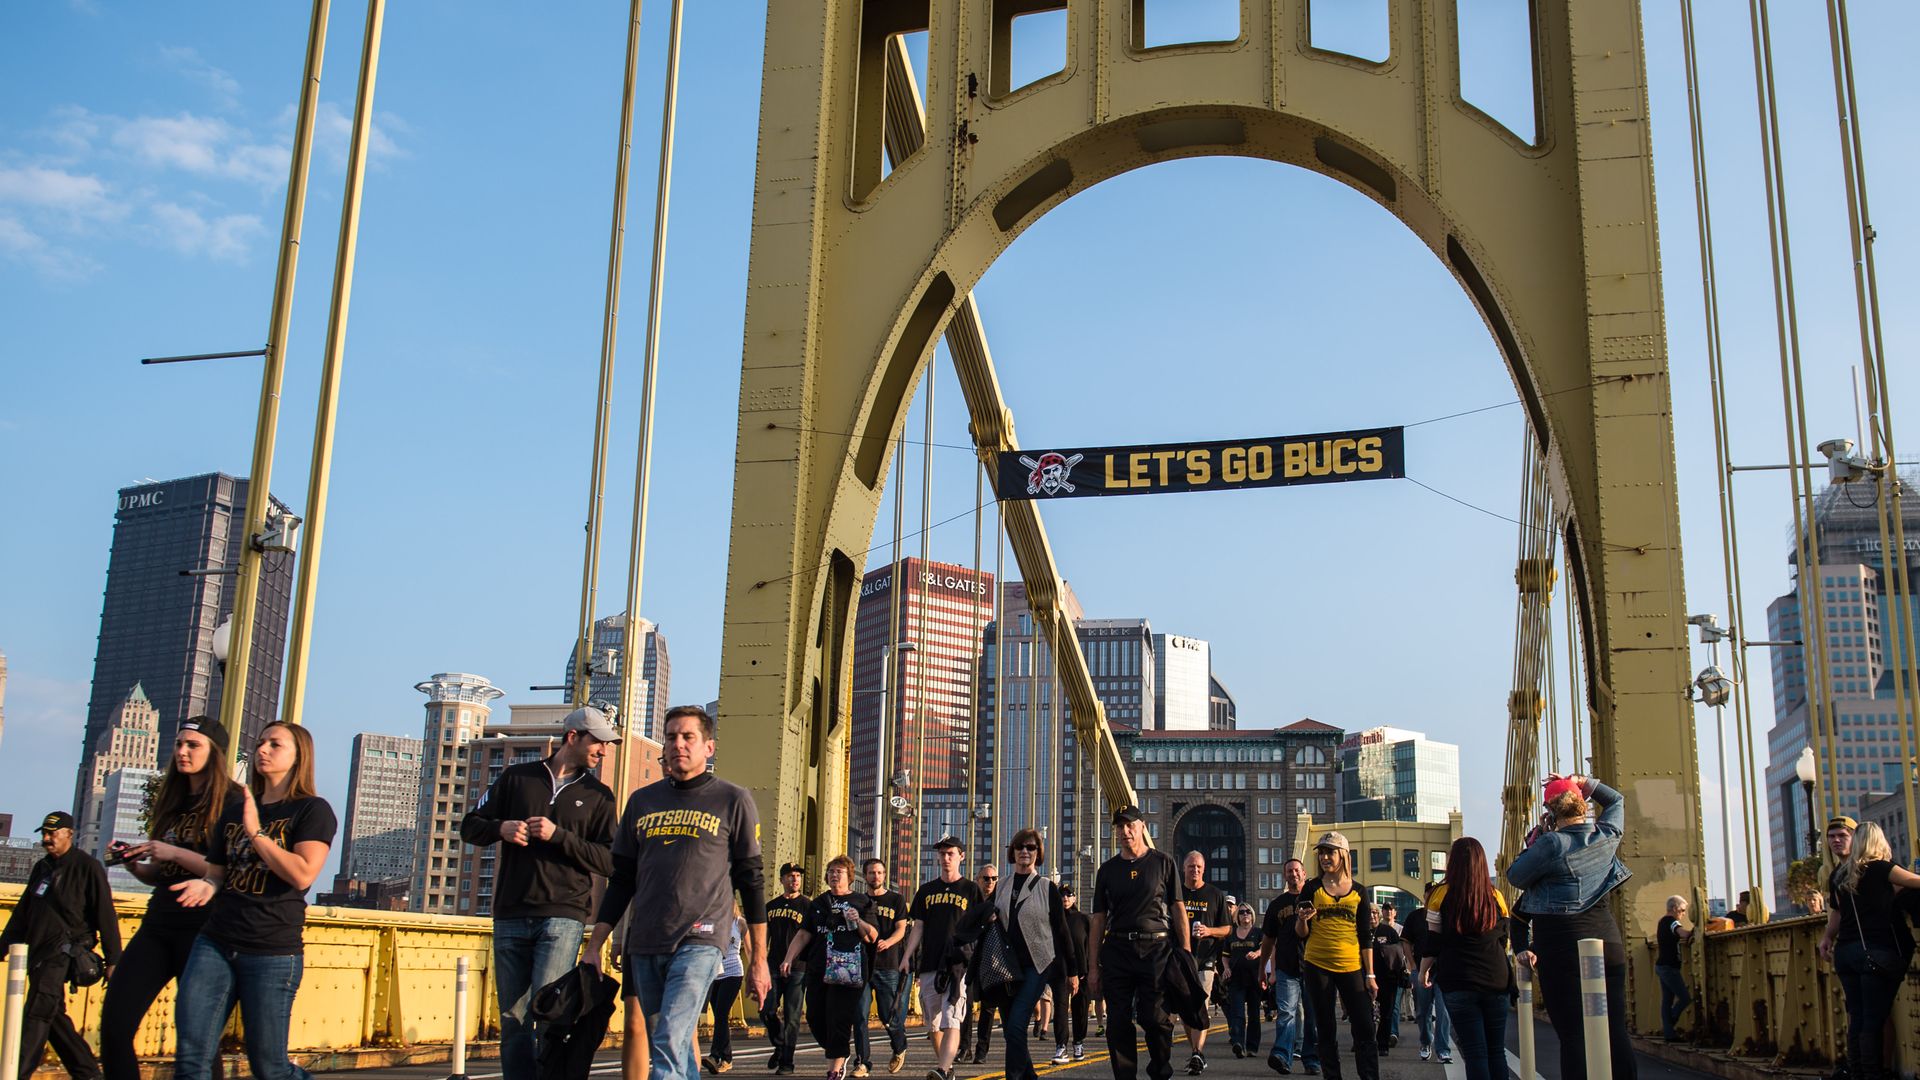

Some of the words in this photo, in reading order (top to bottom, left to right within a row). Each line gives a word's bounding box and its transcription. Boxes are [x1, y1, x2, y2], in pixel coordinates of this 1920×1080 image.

[1104, 449, 1211, 489] LET'S
[1221, 445, 1272, 483] GO
[1283, 436, 1383, 478] BUCS
[118, 490, 164, 510] UPMC
[874, 576, 893, 591] GAT
[944, 576, 987, 595] GATES
[1120, 804, 1128, 813] P
[636, 809, 721, 837] PITTSBURGH
[646, 825, 700, 839] BASEBALL
[1130, 870, 1138, 880] P
[924, 892, 968, 911] PIRATES
[768, 908, 803, 924] PIRATES
